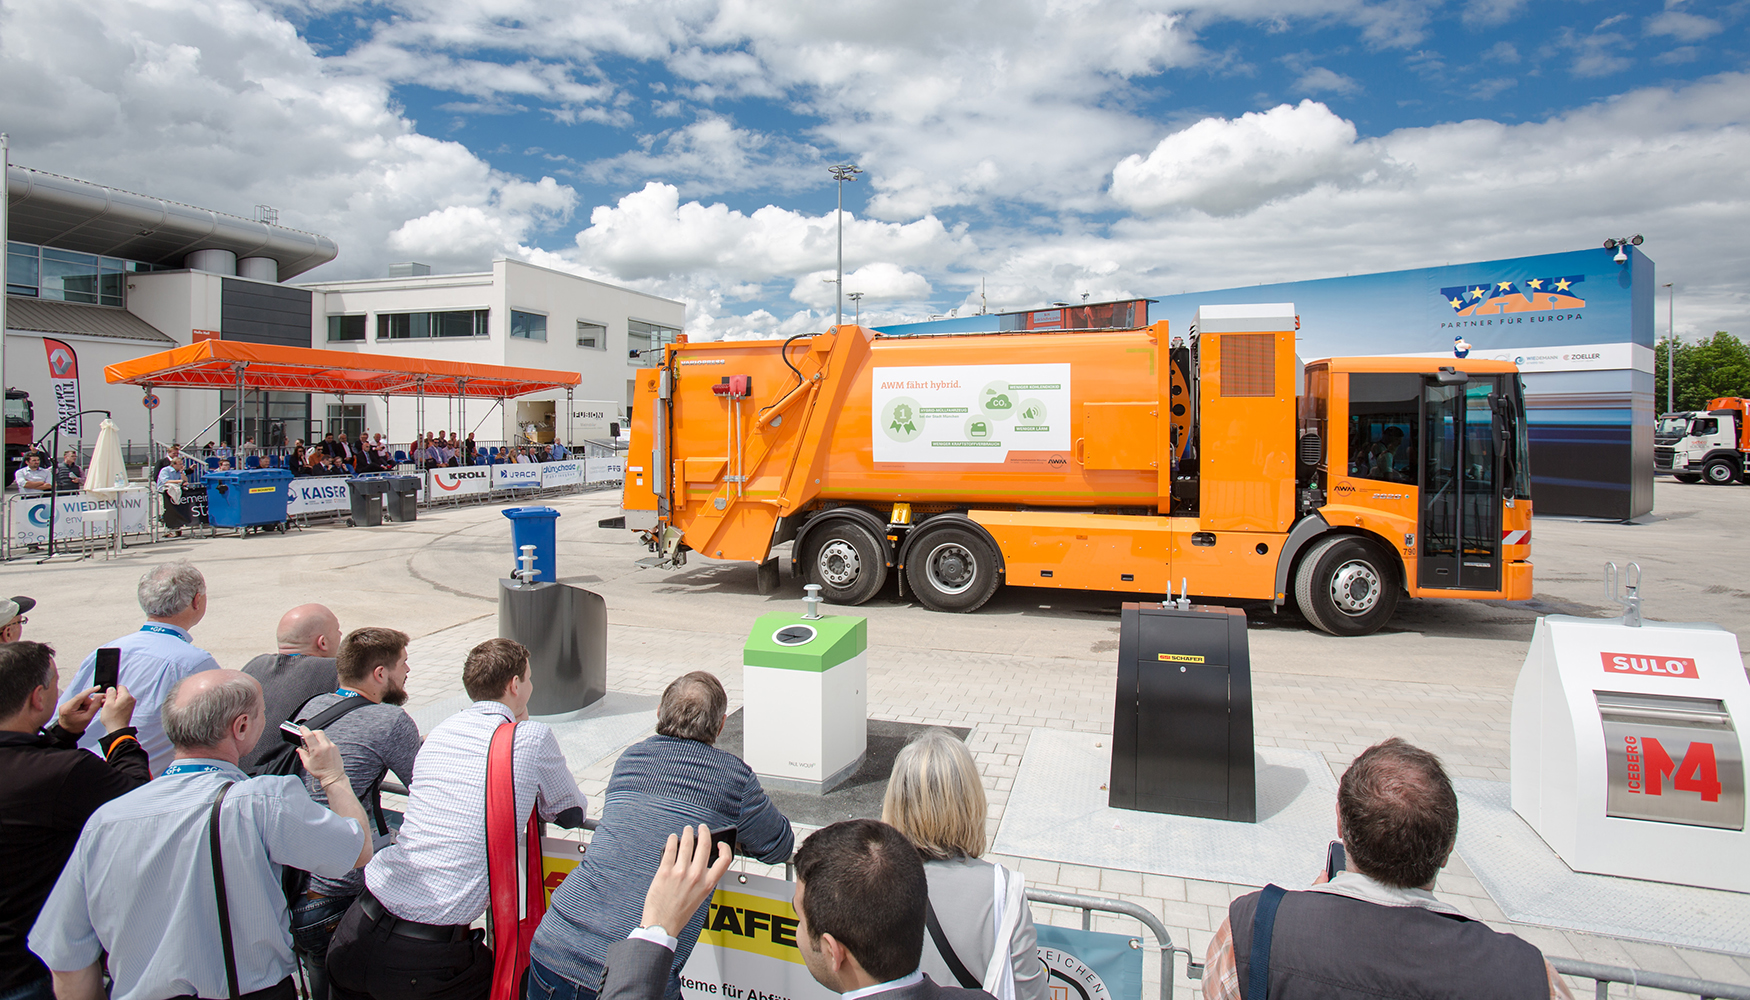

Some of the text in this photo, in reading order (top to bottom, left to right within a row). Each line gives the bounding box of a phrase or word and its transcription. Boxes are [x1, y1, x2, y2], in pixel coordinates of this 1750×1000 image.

[1440, 274, 1586, 317] VAK
[1441, 313, 1582, 328] PARTNER FÜR EUROPA
[906, 380, 928, 389] fährt
[930, 380, 961, 390] hybrid.
[449, 471, 486, 480] KROLL
[302, 486, 346, 500] KAISER
[1624, 736, 1641, 794] ICEBERG
[1640, 737, 1722, 802] M4
[702, 904, 800, 948] ÄFE
[681, 975, 717, 994] teme
[722, 983, 743, 999] für
